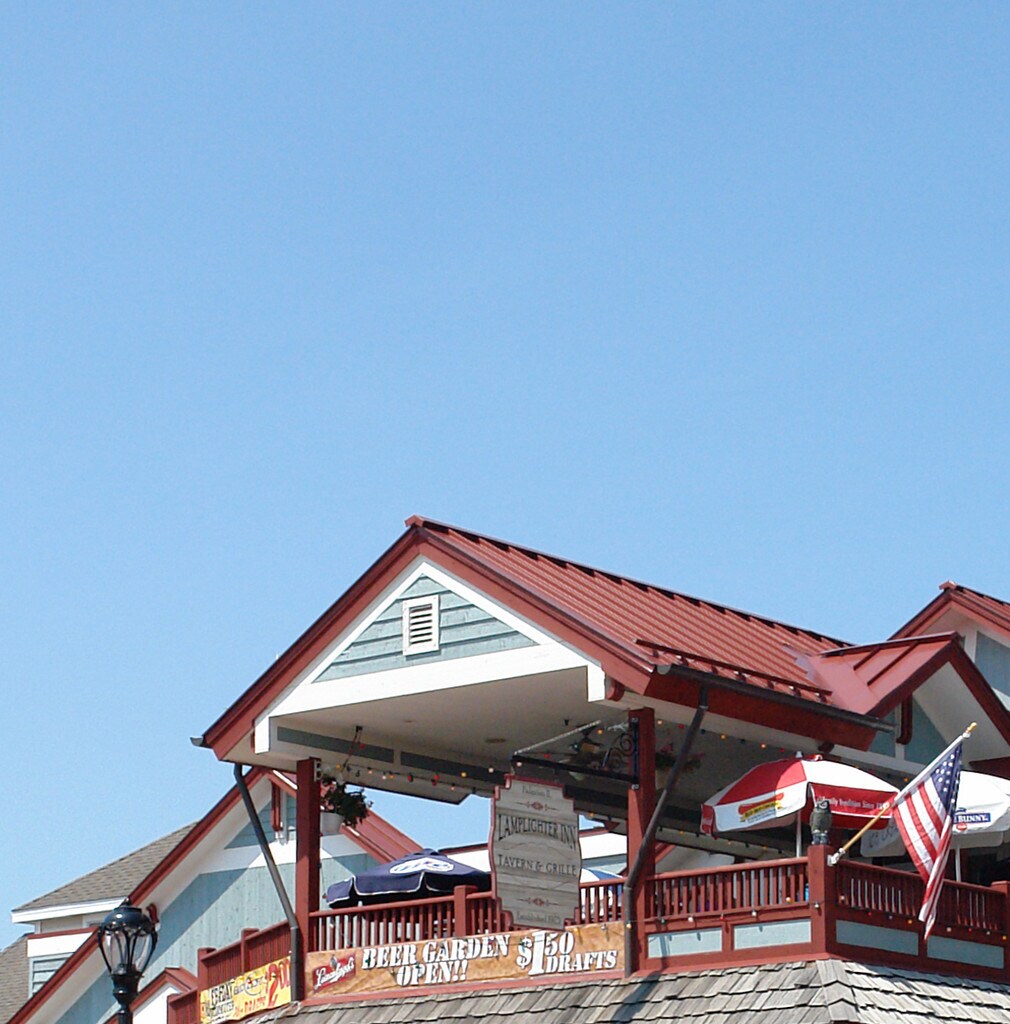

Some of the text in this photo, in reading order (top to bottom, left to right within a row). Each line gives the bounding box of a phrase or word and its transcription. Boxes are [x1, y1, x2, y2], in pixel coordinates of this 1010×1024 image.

[497, 813, 578, 851] LAMPLIGHTER INN
[498, 854, 577, 877] TAVERN & GRILLE
[361, 934, 511, 970] BEER GARDEN
[545, 950, 618, 973] DRAFTS
[396, 959, 469, 986] OPEN!!
